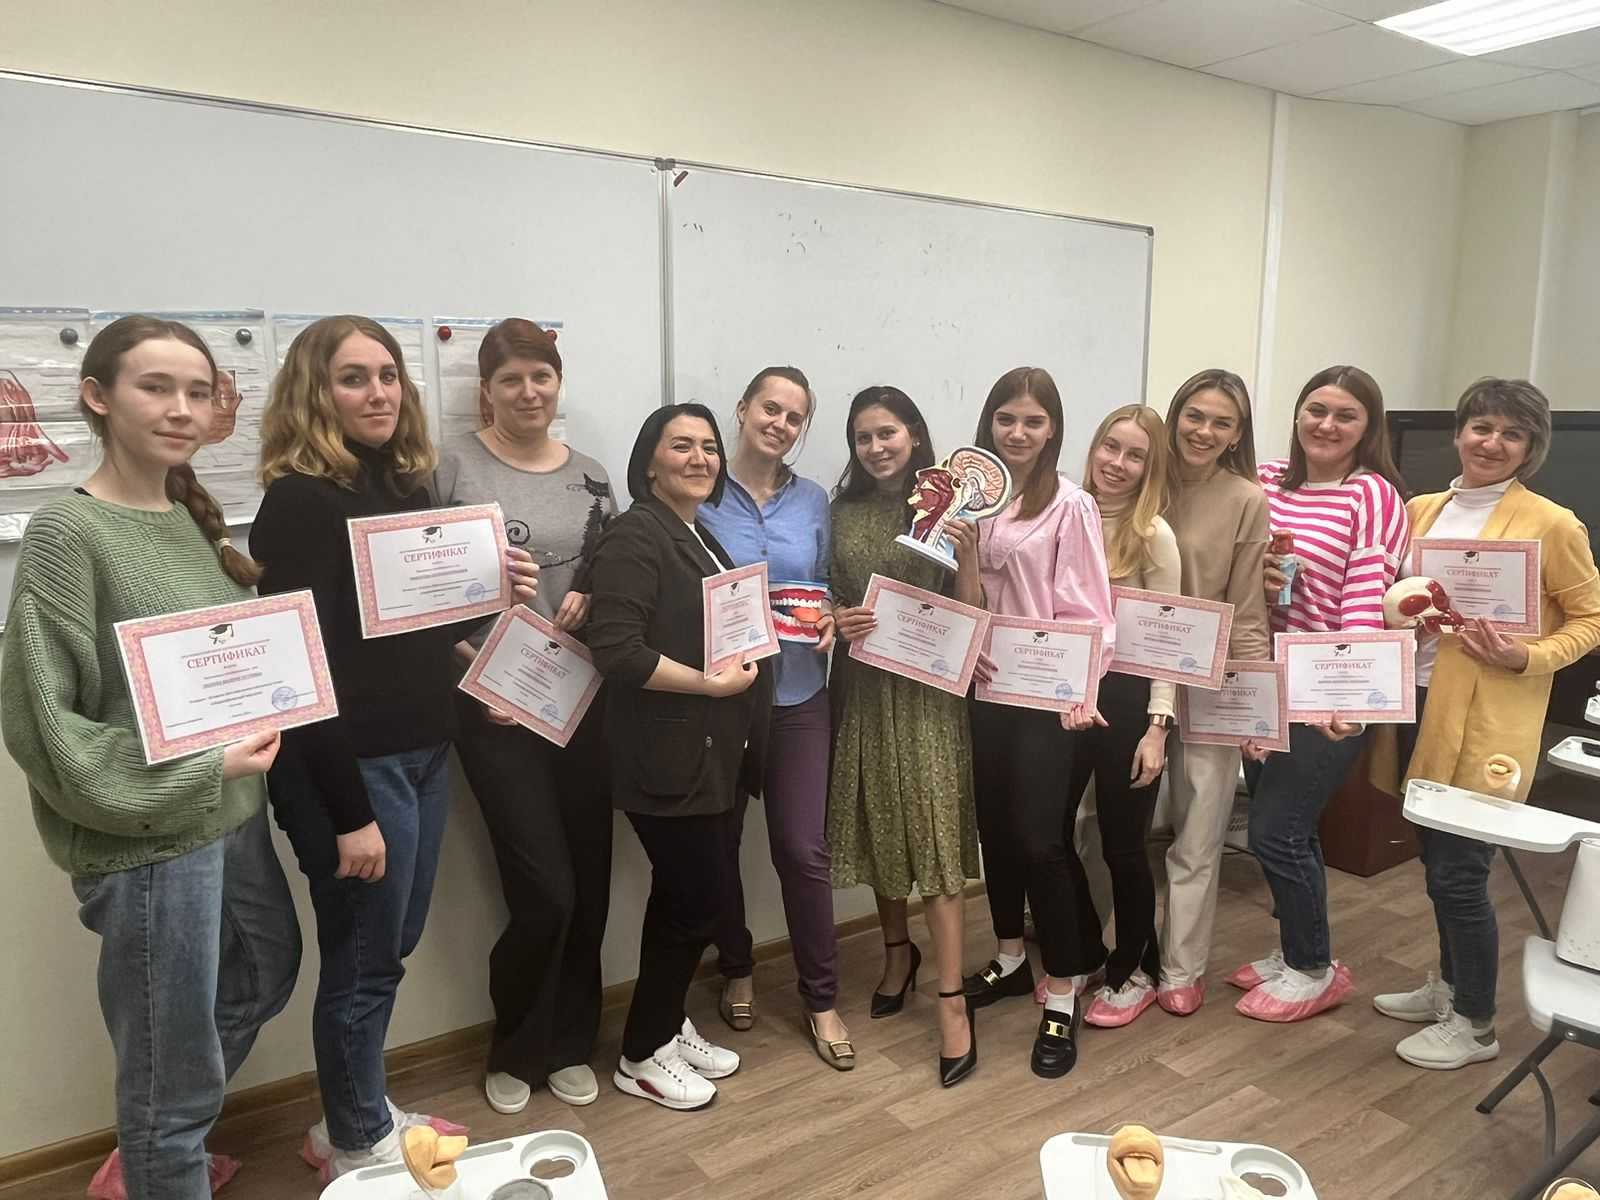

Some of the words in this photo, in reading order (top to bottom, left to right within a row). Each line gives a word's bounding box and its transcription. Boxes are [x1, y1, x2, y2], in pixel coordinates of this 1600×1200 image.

[403, 545, 469, 563] СЕРТИФИКАТ
[897, 614, 949, 636] СЕРТИФИКАТ
[1137, 619, 1192, 634] СЕРТИФИКАТ
[187, 644, 268, 670] СЕРТИФИКАТ
[1014, 646, 1065, 660] СЕРТИФИКАТ
[1314, 661, 1373, 671] СЕРТИФИКАТ
